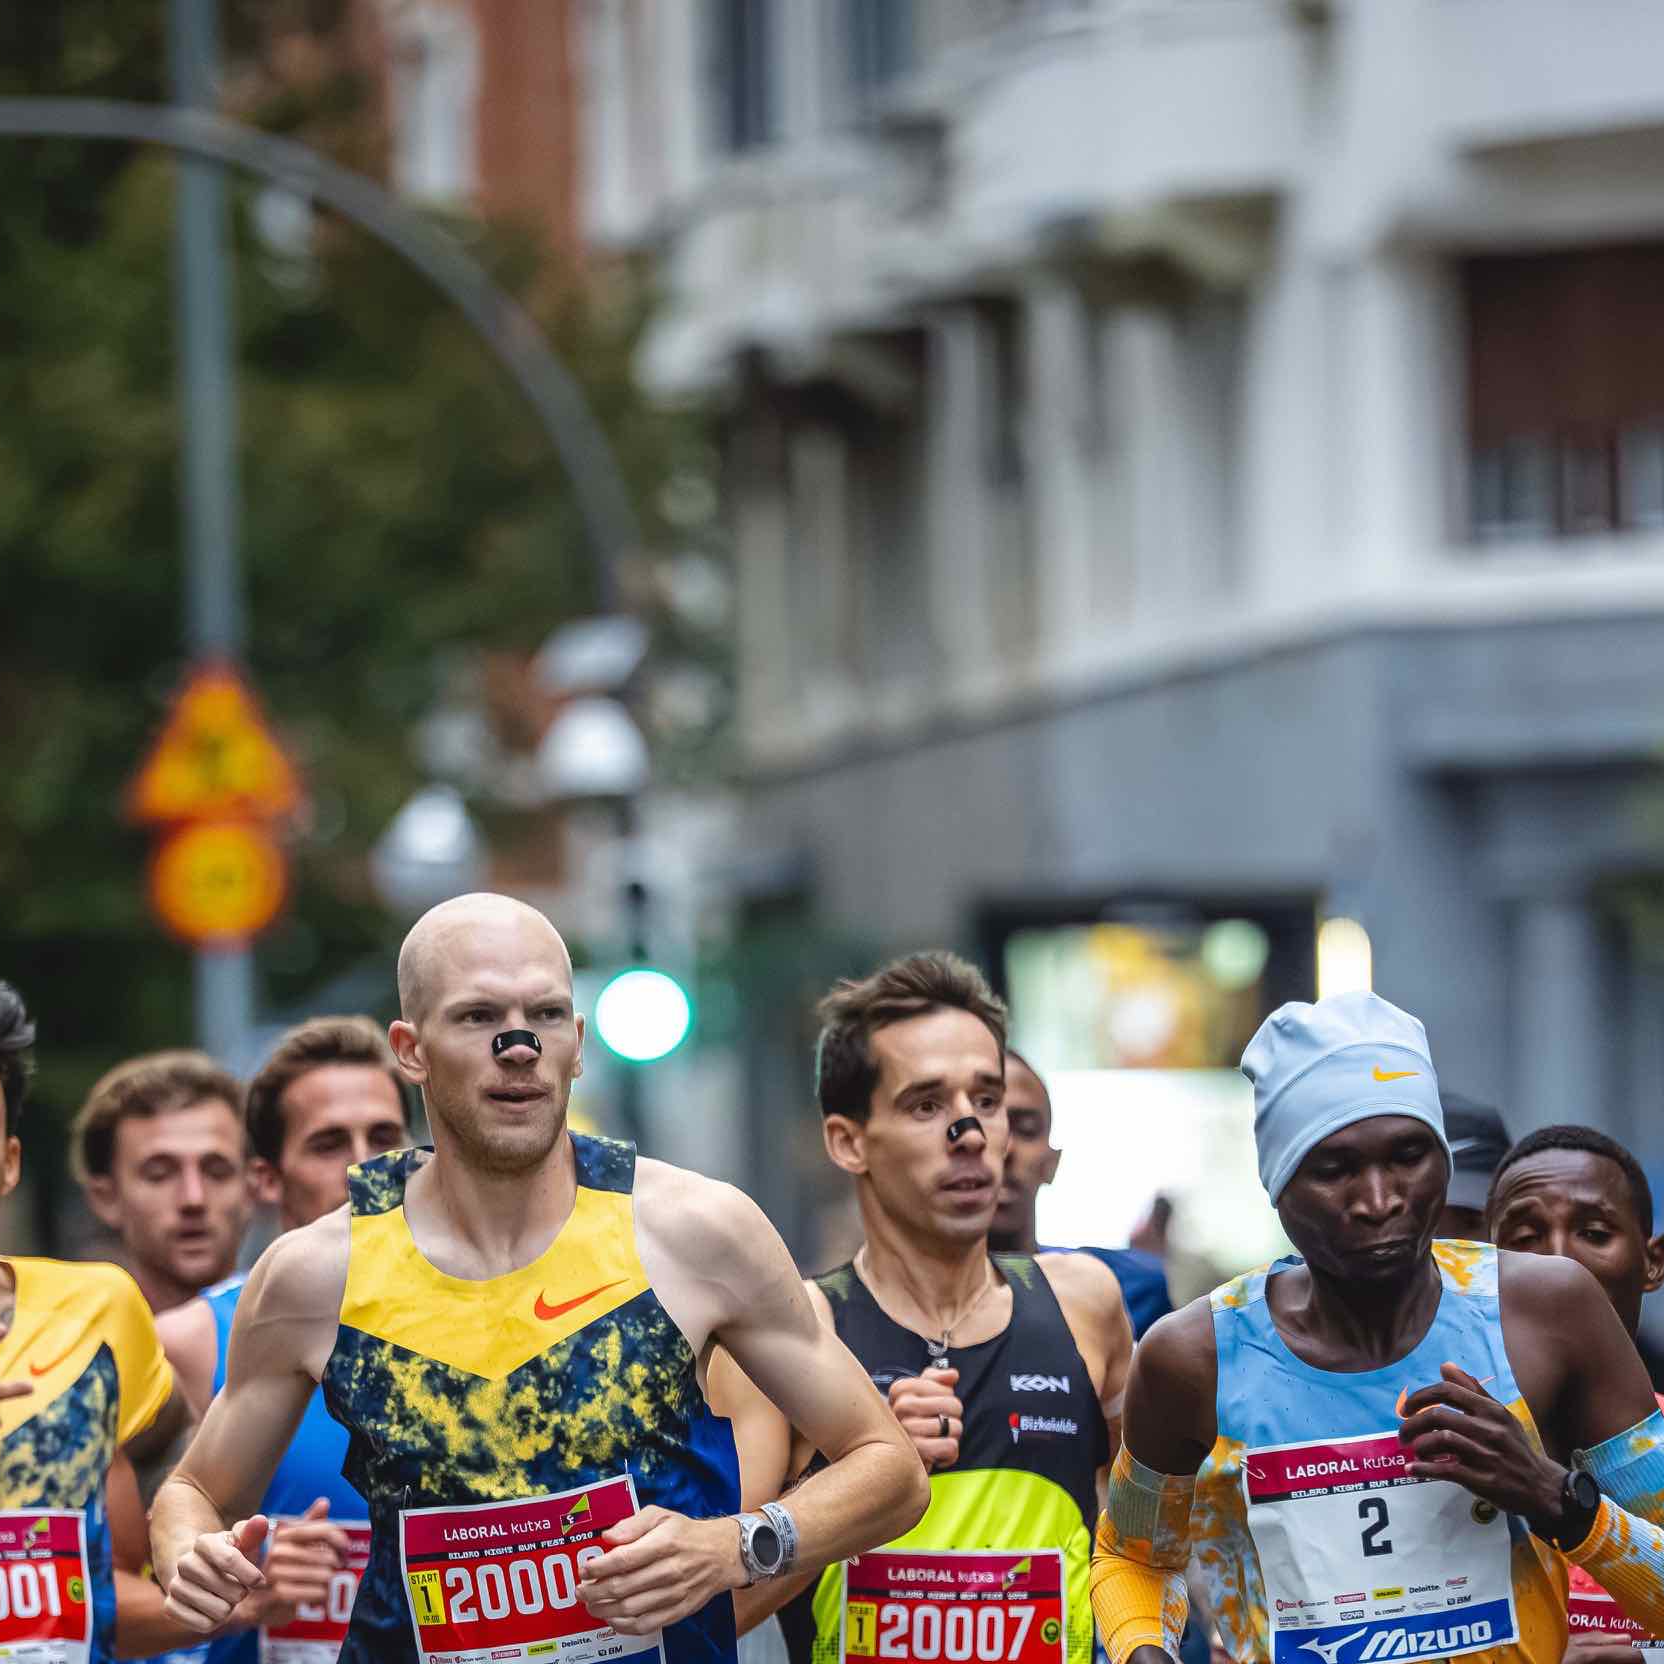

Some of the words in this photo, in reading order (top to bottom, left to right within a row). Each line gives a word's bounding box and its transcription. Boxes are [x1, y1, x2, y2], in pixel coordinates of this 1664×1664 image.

[1286, 1458, 1360, 1480] LABORAL
[1363, 1453, 1406, 1470] kutxa
[443, 1525, 508, 1541] LABORAL
[511, 1518, 551, 1535] kutxa
[1358, 1497, 1393, 1557] 2
[887, 1568, 954, 1583] LABORAL
[420, 1585, 432, 1613] 1
[855, 1616, 864, 1643] 1
[879, 1603, 1036, 1662] 20007
[1567, 1614, 1607, 1628] ORAL
